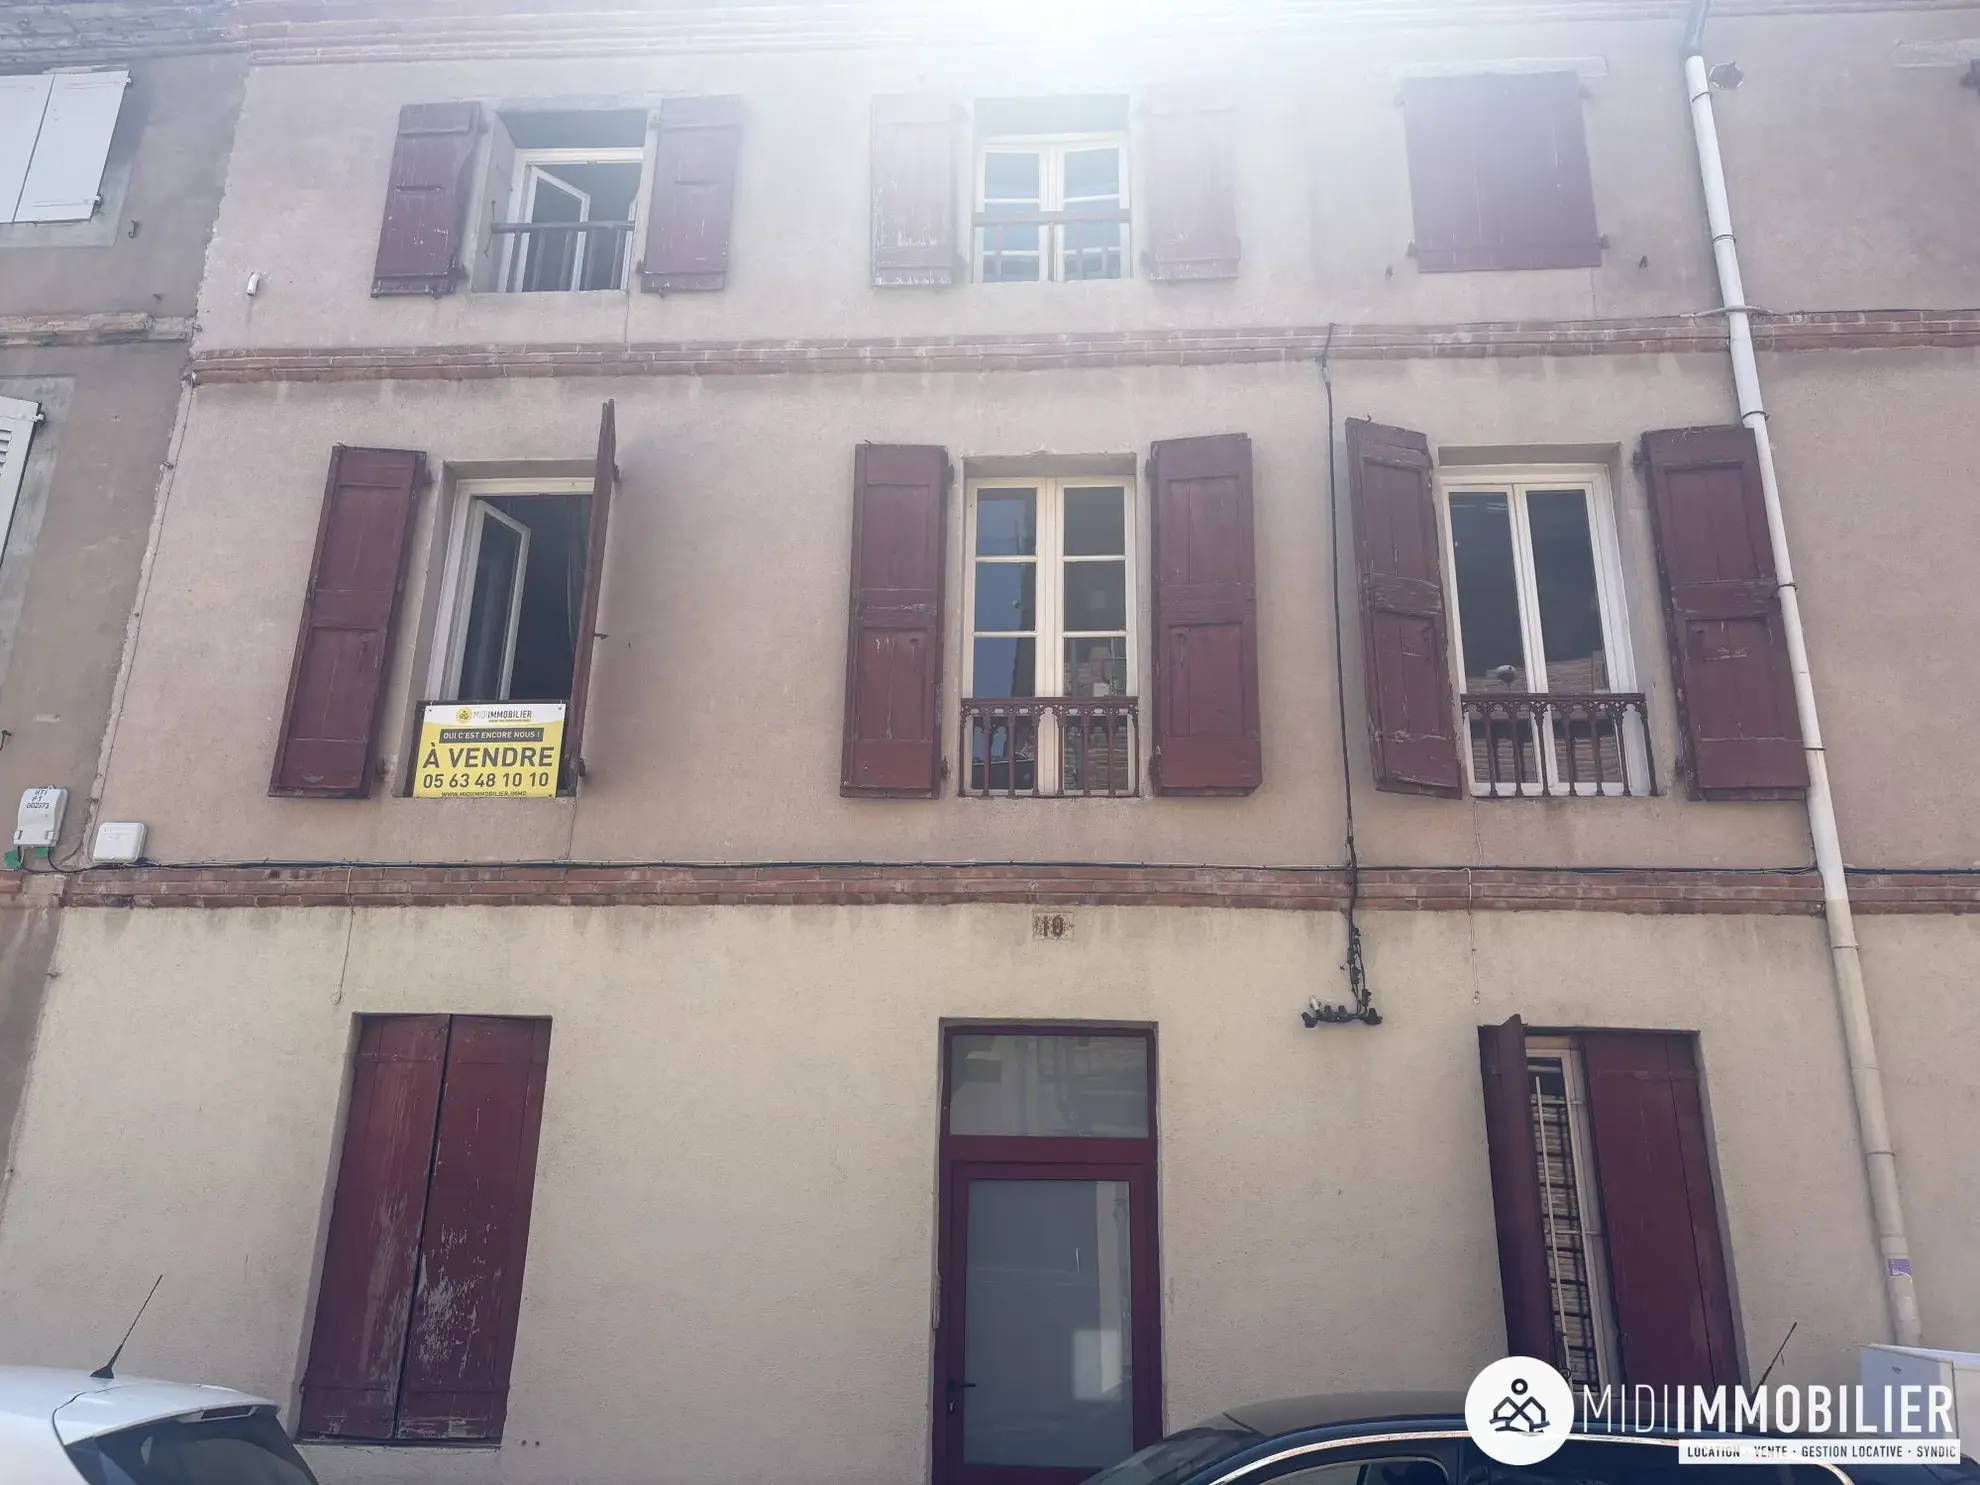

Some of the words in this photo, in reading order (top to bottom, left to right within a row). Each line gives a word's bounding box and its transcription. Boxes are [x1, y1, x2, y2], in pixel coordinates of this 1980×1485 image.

[457, 731, 480, 739] C'EST
[481, 731, 512, 739] ENCORE
[513, 730, 535, 738] NOUS
[423, 742, 440, 768] À
[448, 747, 554, 768] VENDRE
[423, 774, 445, 788] 05
[449, 773, 470, 788] 63
[474, 773, 496, 788] 48
[502, 772, 523, 787] 10
[529, 772, 549, 787] 10
